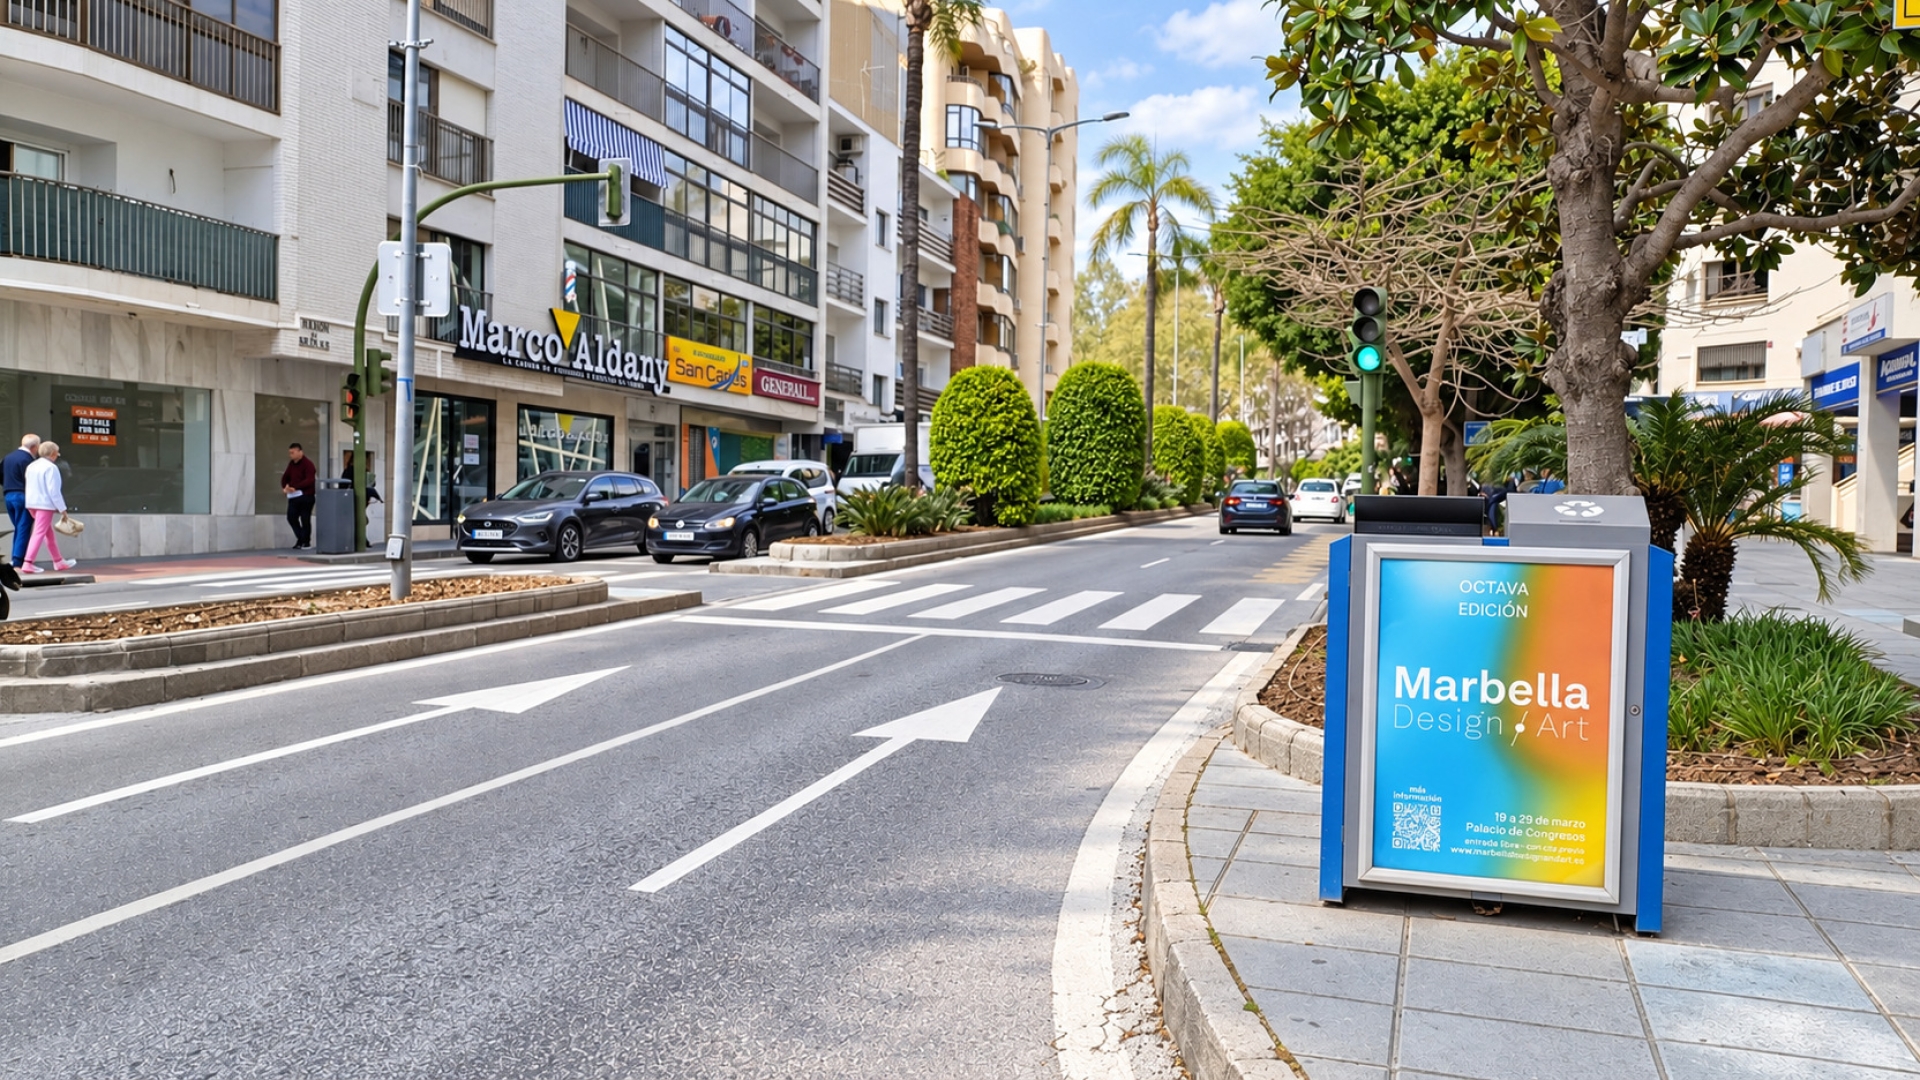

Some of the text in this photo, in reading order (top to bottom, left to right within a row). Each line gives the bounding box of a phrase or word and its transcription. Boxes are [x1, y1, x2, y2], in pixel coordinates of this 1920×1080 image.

[459, 305, 563, 365] Marco
[572, 332, 669, 395] Aldany
[675, 357, 747, 388] San Caros
[1459, 579, 1529, 596] OCTAVA
[1458, 600, 1528, 618] EDICIÓN
[1395, 665, 1590, 710] Marbella
[1394, 703, 1589, 741] Design Art
[1393, 790, 1442, 802] información
[1409, 785, 1426, 794] más
[1495, 812, 1586, 829] 19 a 29 de marzo
[1466, 822, 1585, 842] Palacio de Congresos
[1465, 838, 1498, 848] entrada
